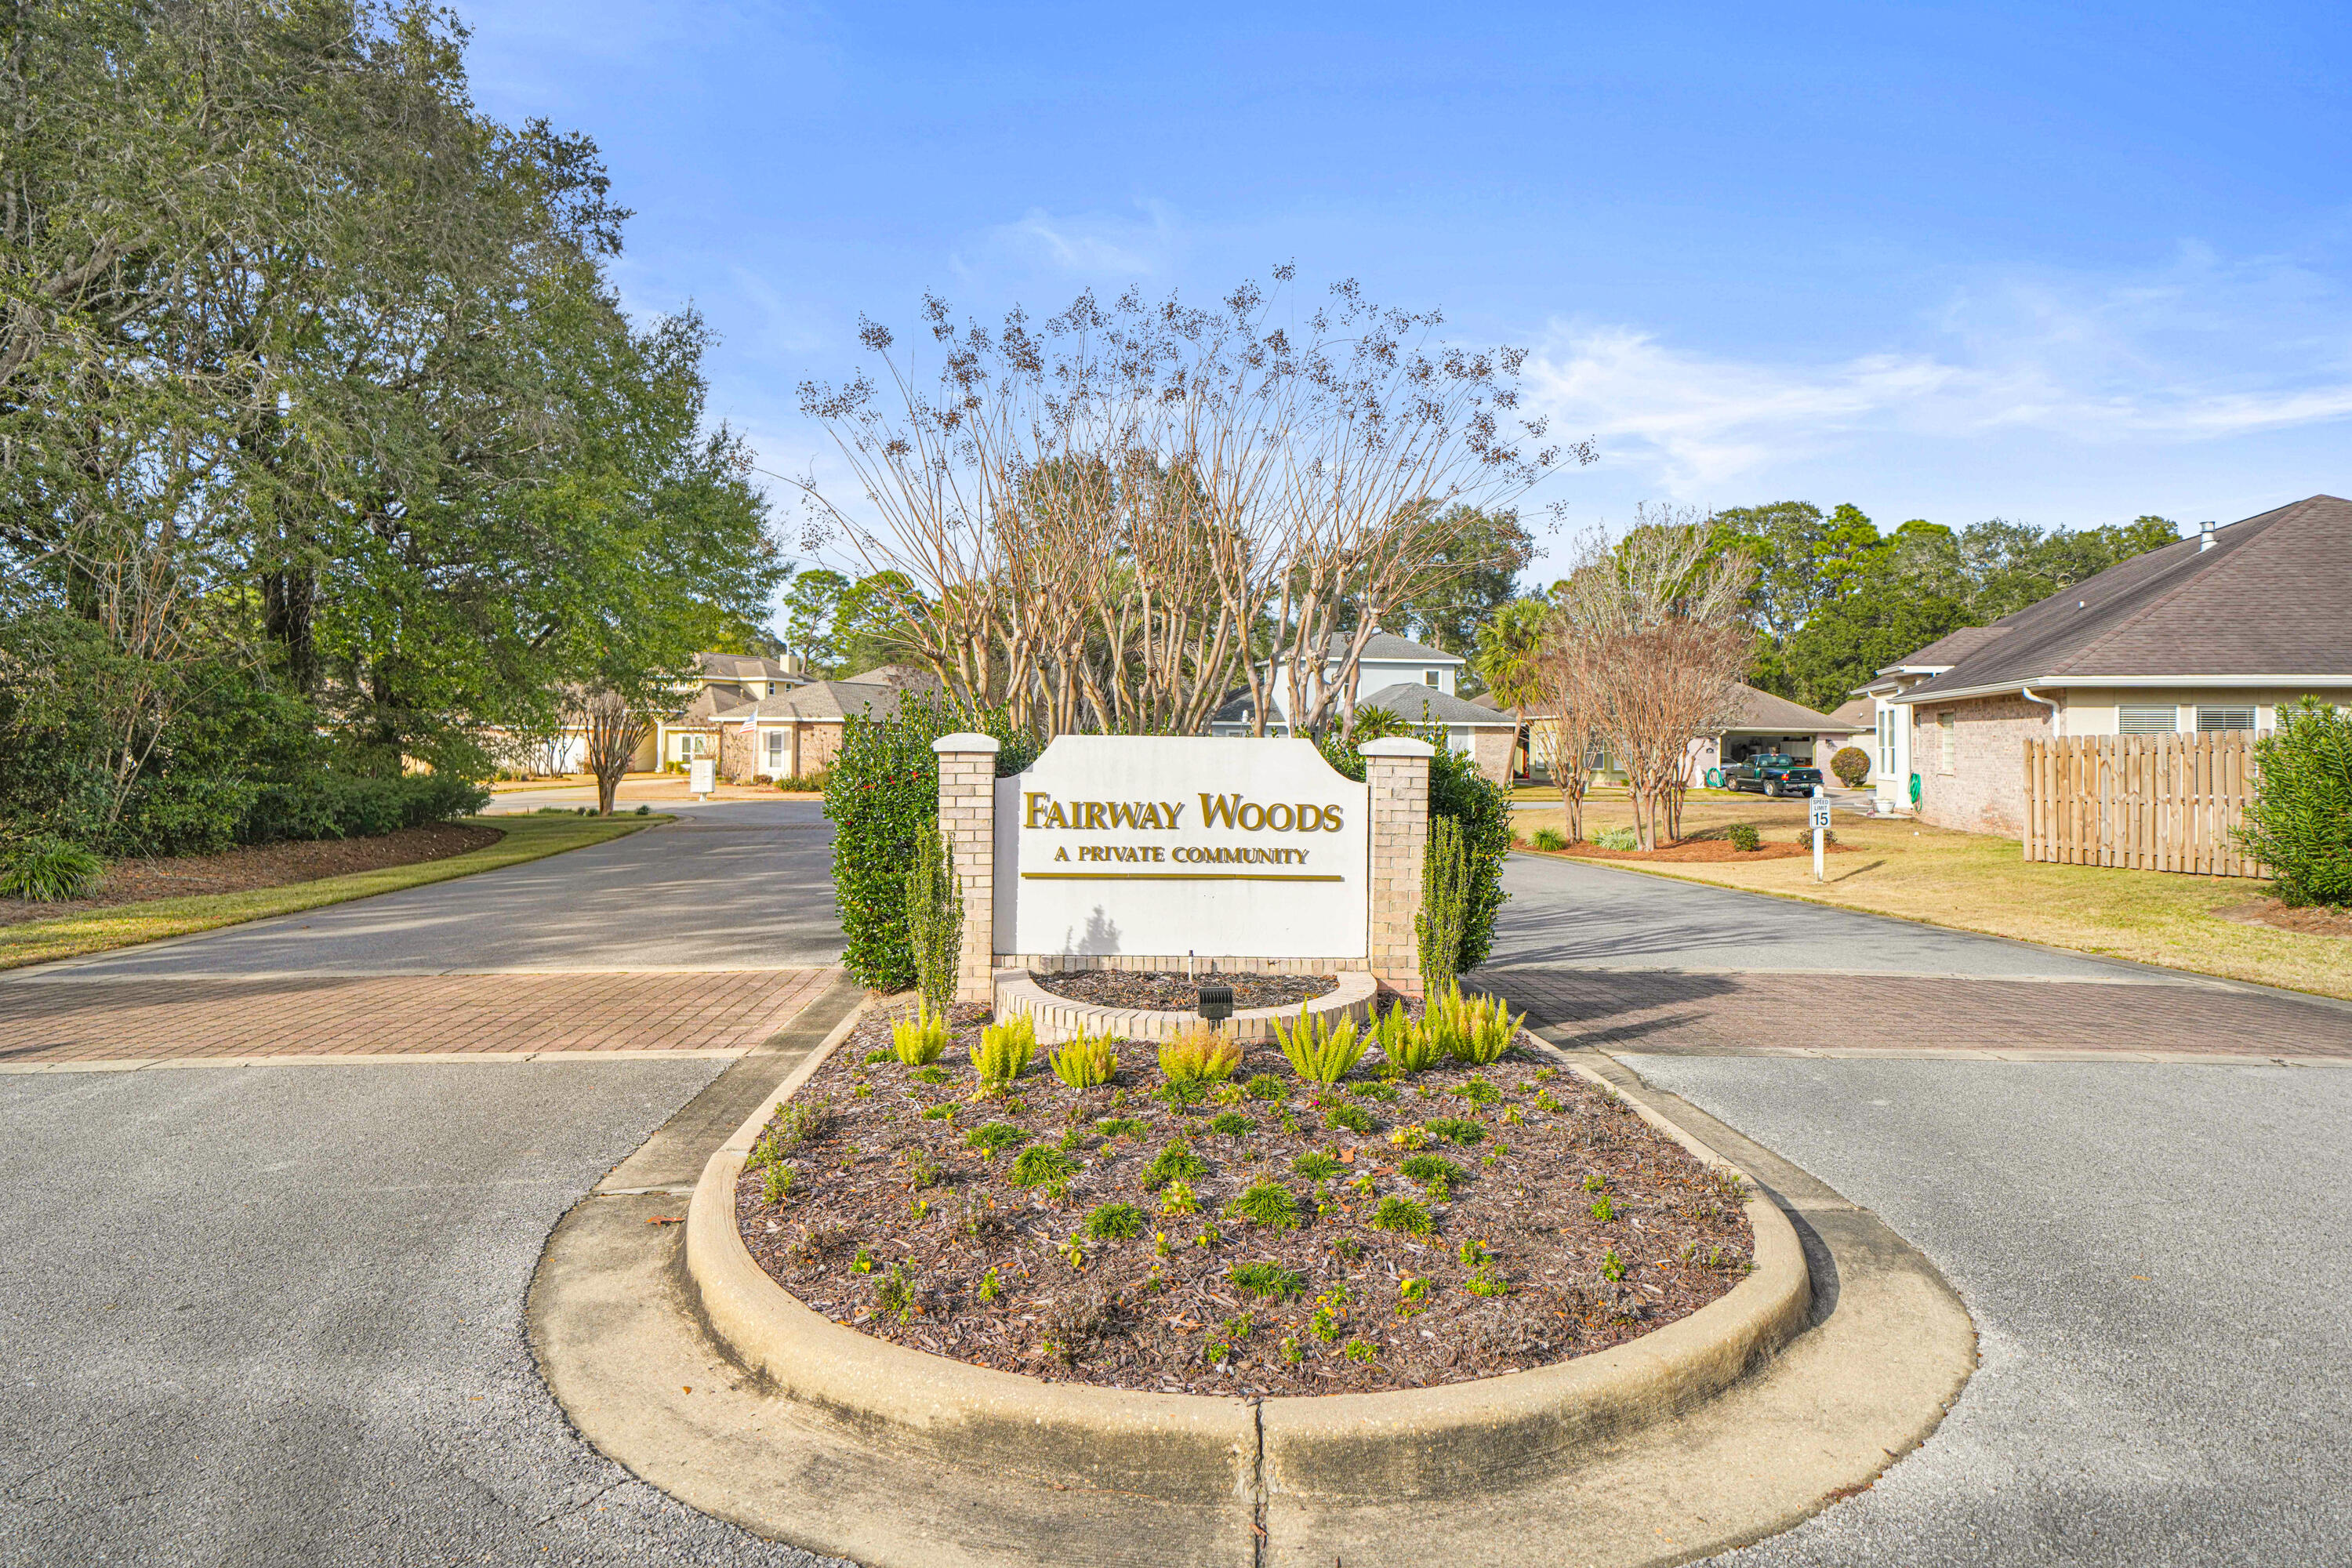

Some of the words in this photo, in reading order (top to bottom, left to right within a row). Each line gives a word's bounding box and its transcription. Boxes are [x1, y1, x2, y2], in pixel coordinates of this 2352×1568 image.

[1023, 792, 1183, 829] FAIRWAY
[1198, 793, 1343, 832] WOODS
[1813, 812, 1828, 826] 15
[1054, 846, 1069, 862] A
[1079, 846, 1164, 862] PRIVATE
[1172, 847, 1308, 864] COMMUNITY
